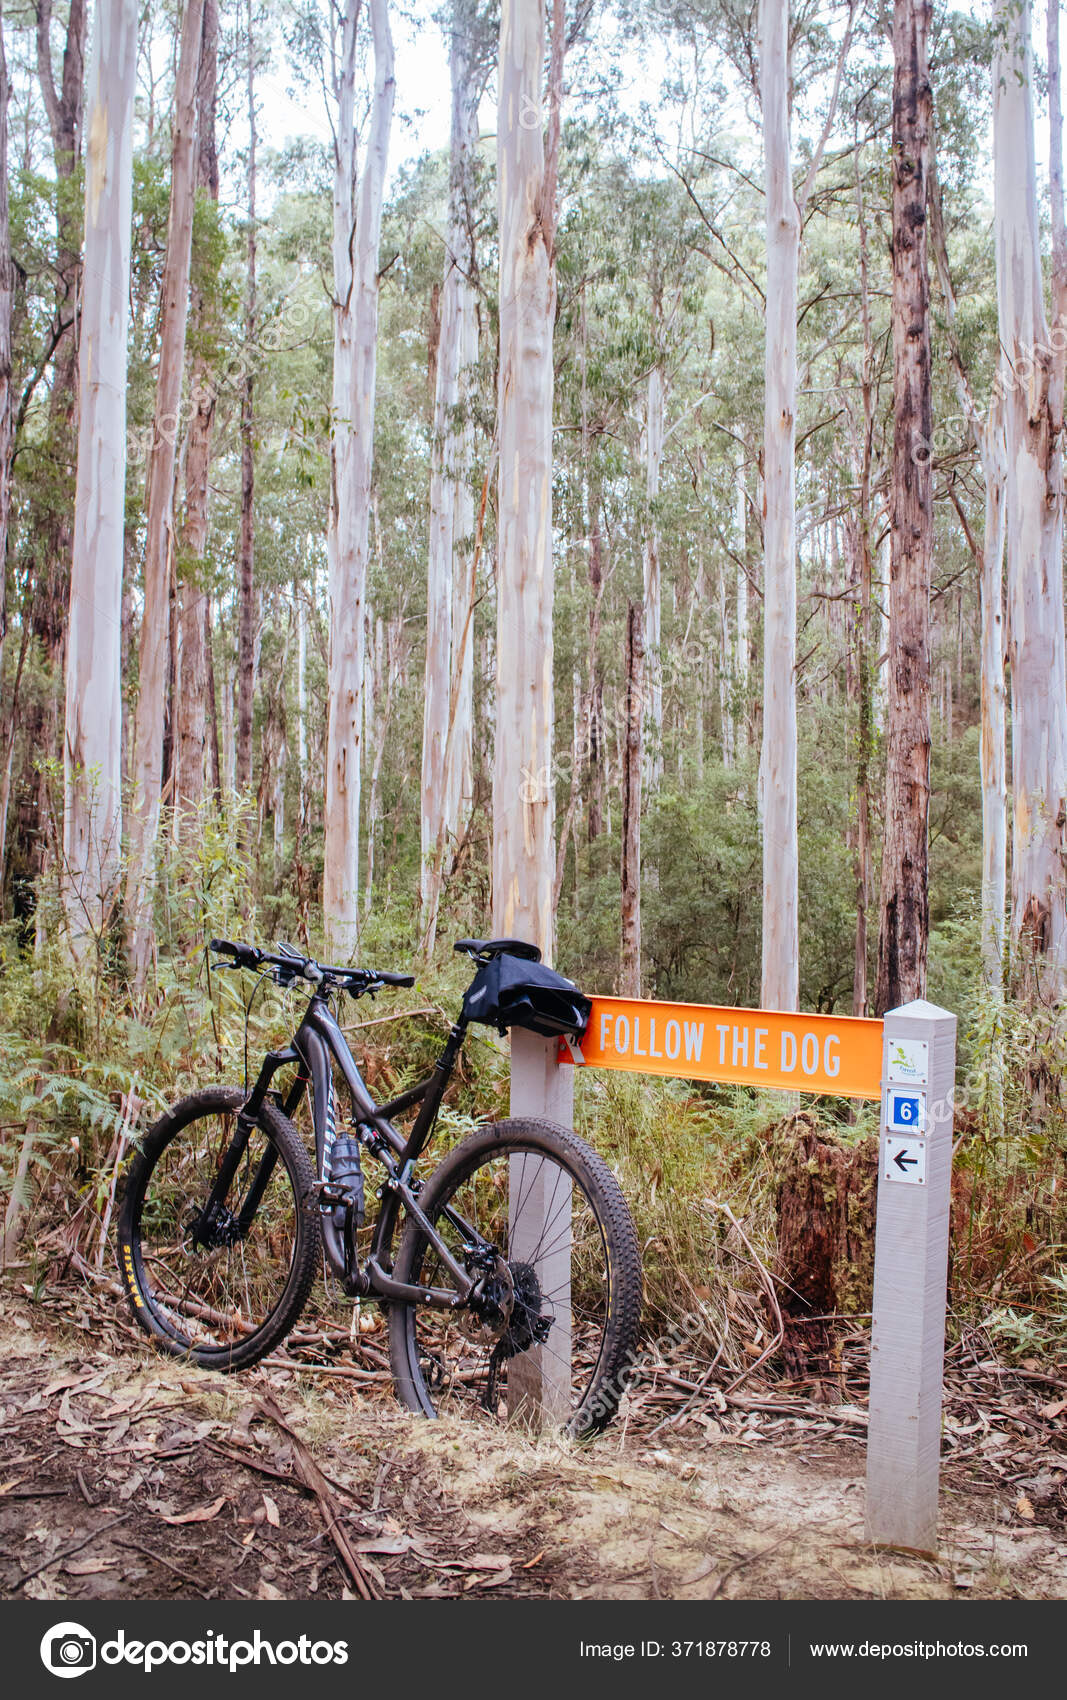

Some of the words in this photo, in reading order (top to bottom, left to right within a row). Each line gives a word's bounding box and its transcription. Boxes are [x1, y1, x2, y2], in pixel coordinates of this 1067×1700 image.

[599, 1013, 705, 1062] FOLLOW
[716, 1024, 769, 1070] THE
[780, 1031, 841, 1077] DOG
[900, 1102, 912, 1121] 6
[123, 1244, 145, 1308] MAXXIS
